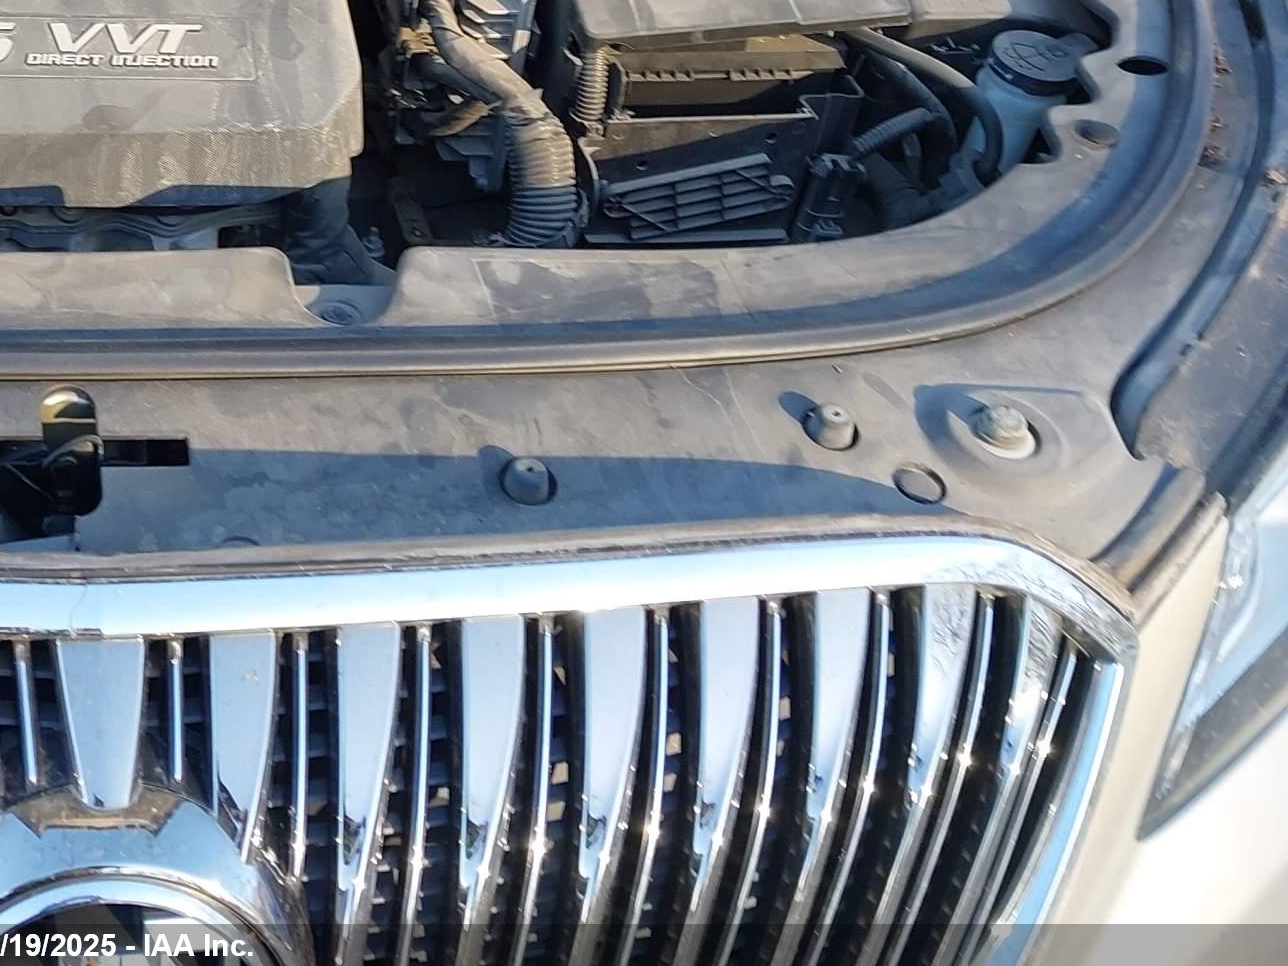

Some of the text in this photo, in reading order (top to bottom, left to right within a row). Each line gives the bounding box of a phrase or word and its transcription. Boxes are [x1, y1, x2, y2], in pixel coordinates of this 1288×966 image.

[47, 22, 204, 54] VVT
[26, 52, 219, 69] DIRECT INJECTION
